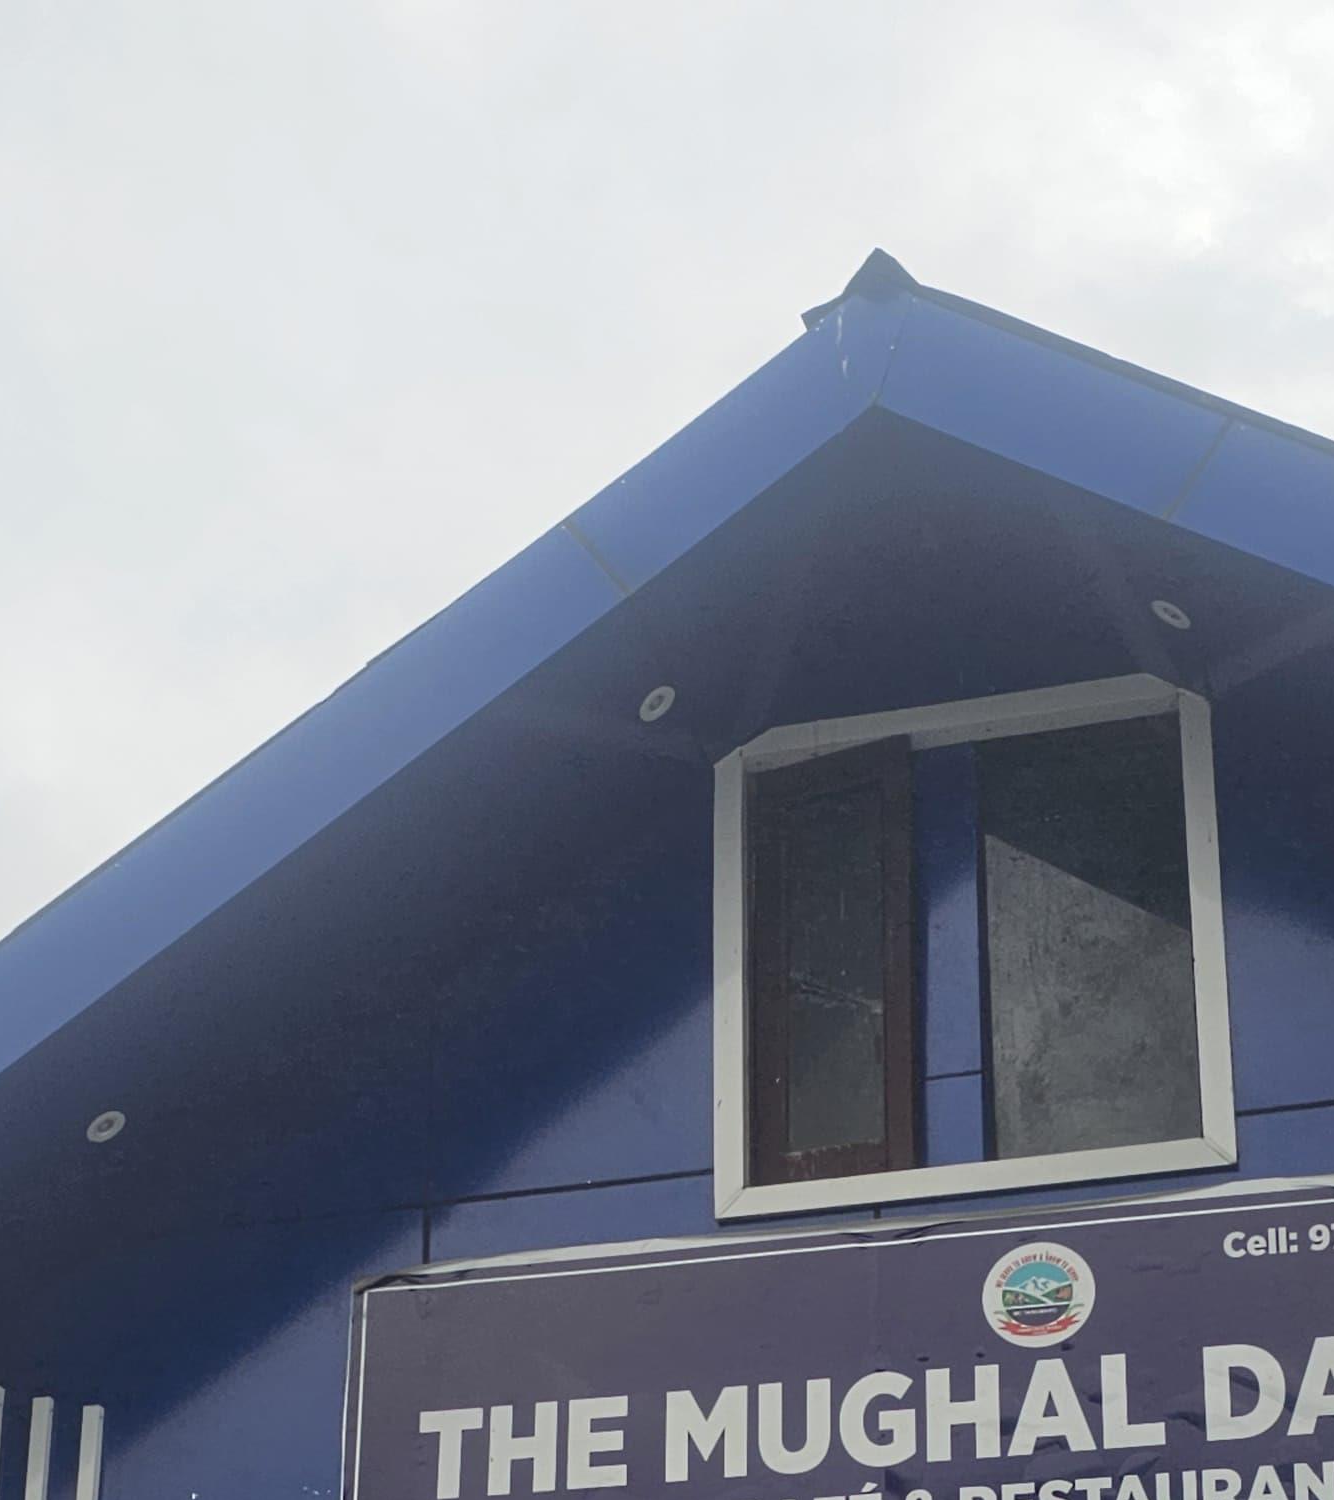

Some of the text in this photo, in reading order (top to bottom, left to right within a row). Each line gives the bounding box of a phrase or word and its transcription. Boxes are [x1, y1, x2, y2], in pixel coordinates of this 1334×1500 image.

[1222, 1230, 1299, 1259] Cell:
[419, 1395, 629, 1500] THE
[665, 1352, 1167, 1483] MUGHAL
